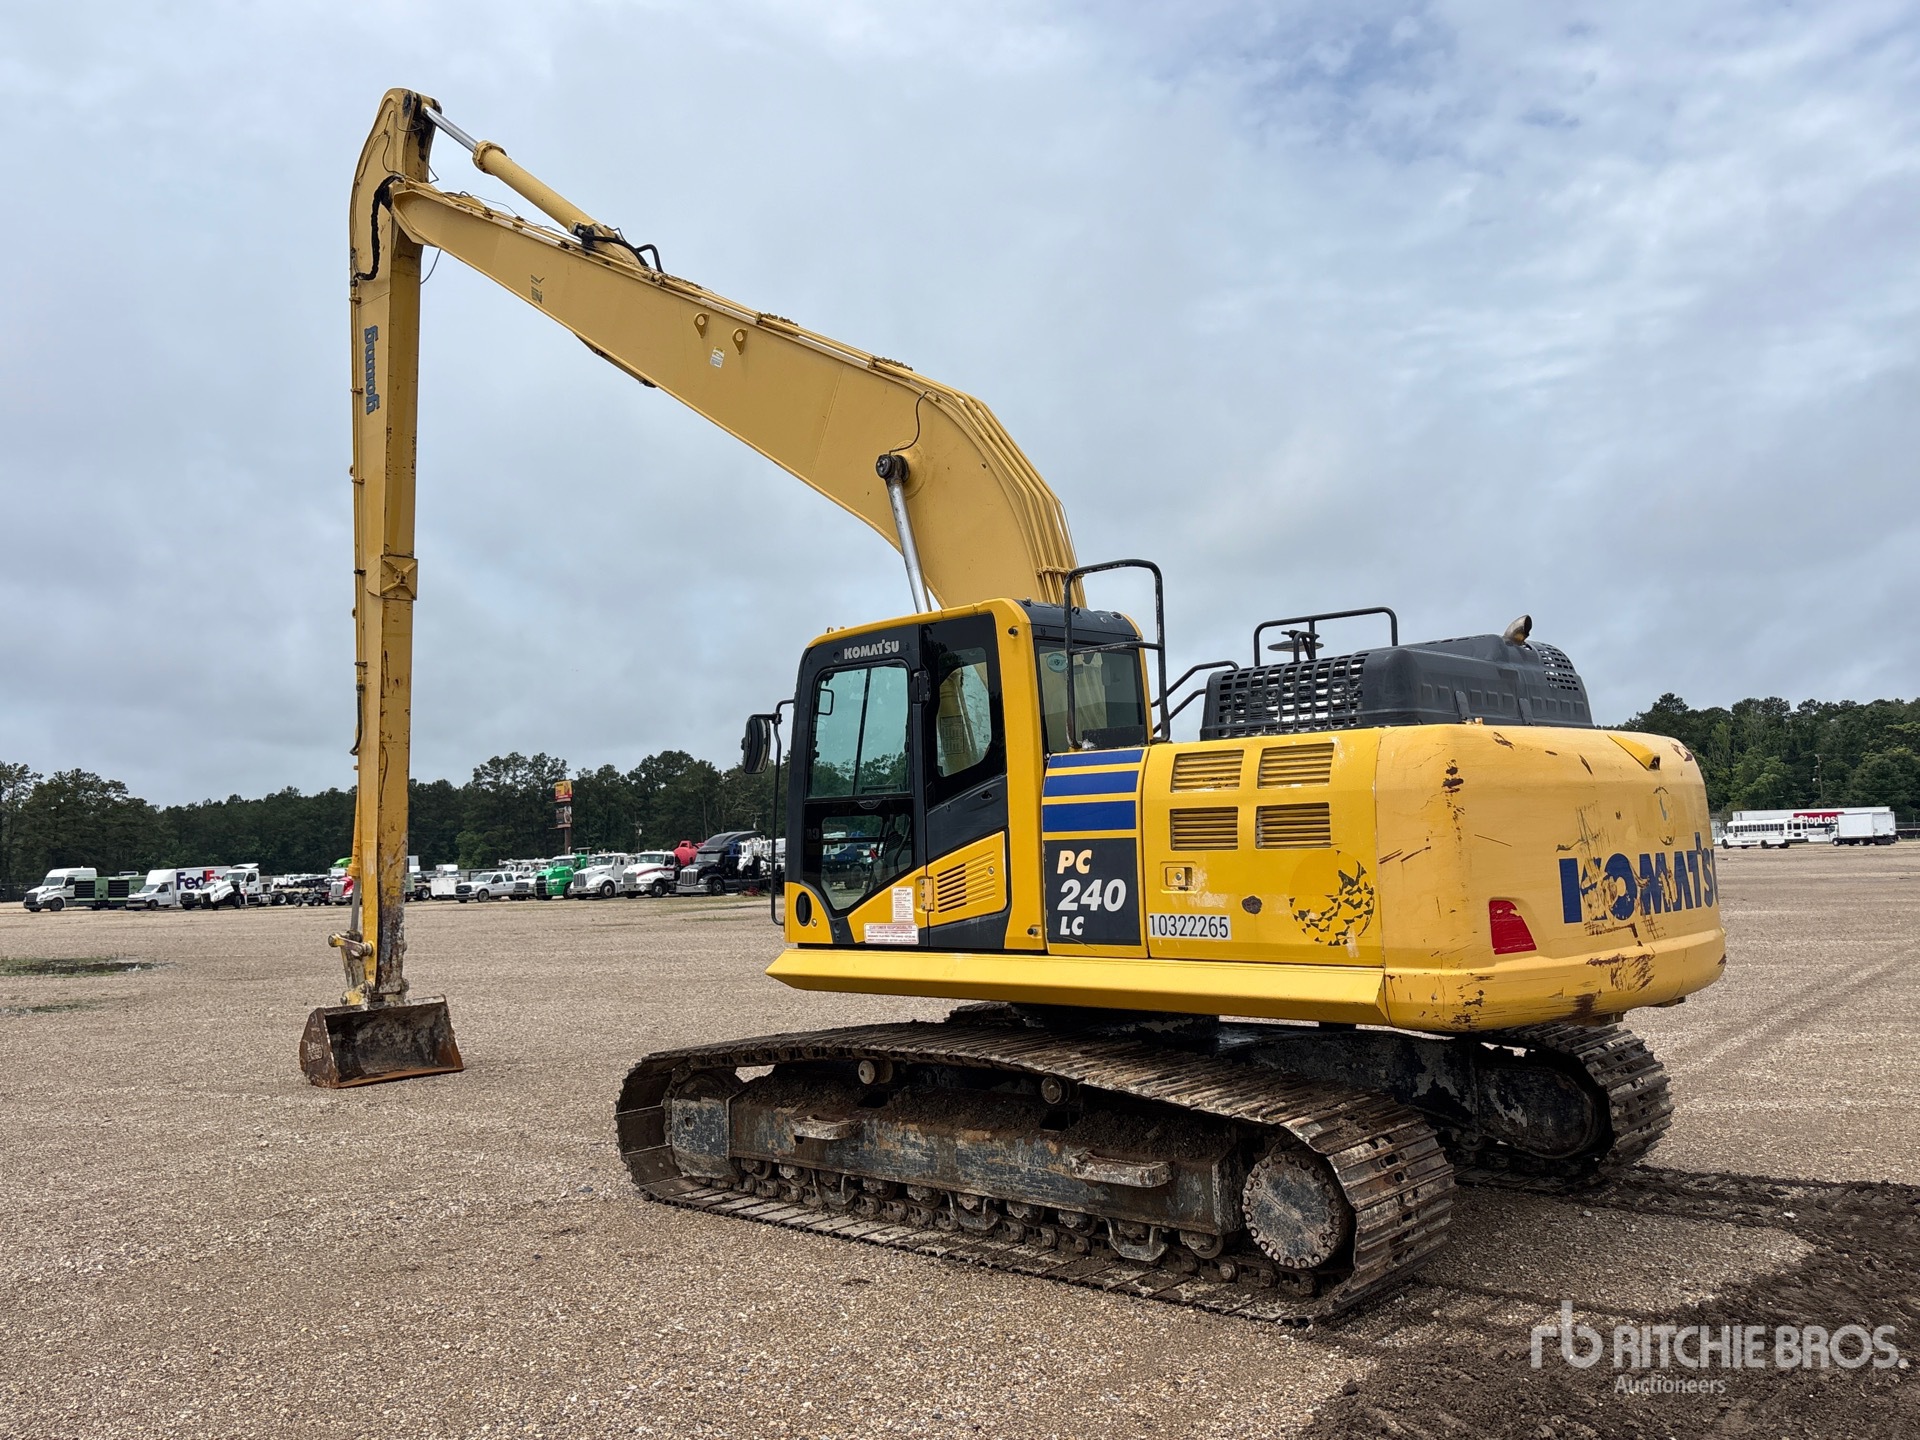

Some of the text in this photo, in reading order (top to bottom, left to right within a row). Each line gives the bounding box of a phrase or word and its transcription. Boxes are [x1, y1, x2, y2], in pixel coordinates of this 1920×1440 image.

[843, 639, 900, 660] KOMATSU
[1056, 849, 1093, 875] PC
[176, 869, 221, 891] FedE
[1056, 878, 1127, 912] 240
[1059, 915, 1085, 936] LC
[1149, 914, 1229, 938] 10322265
